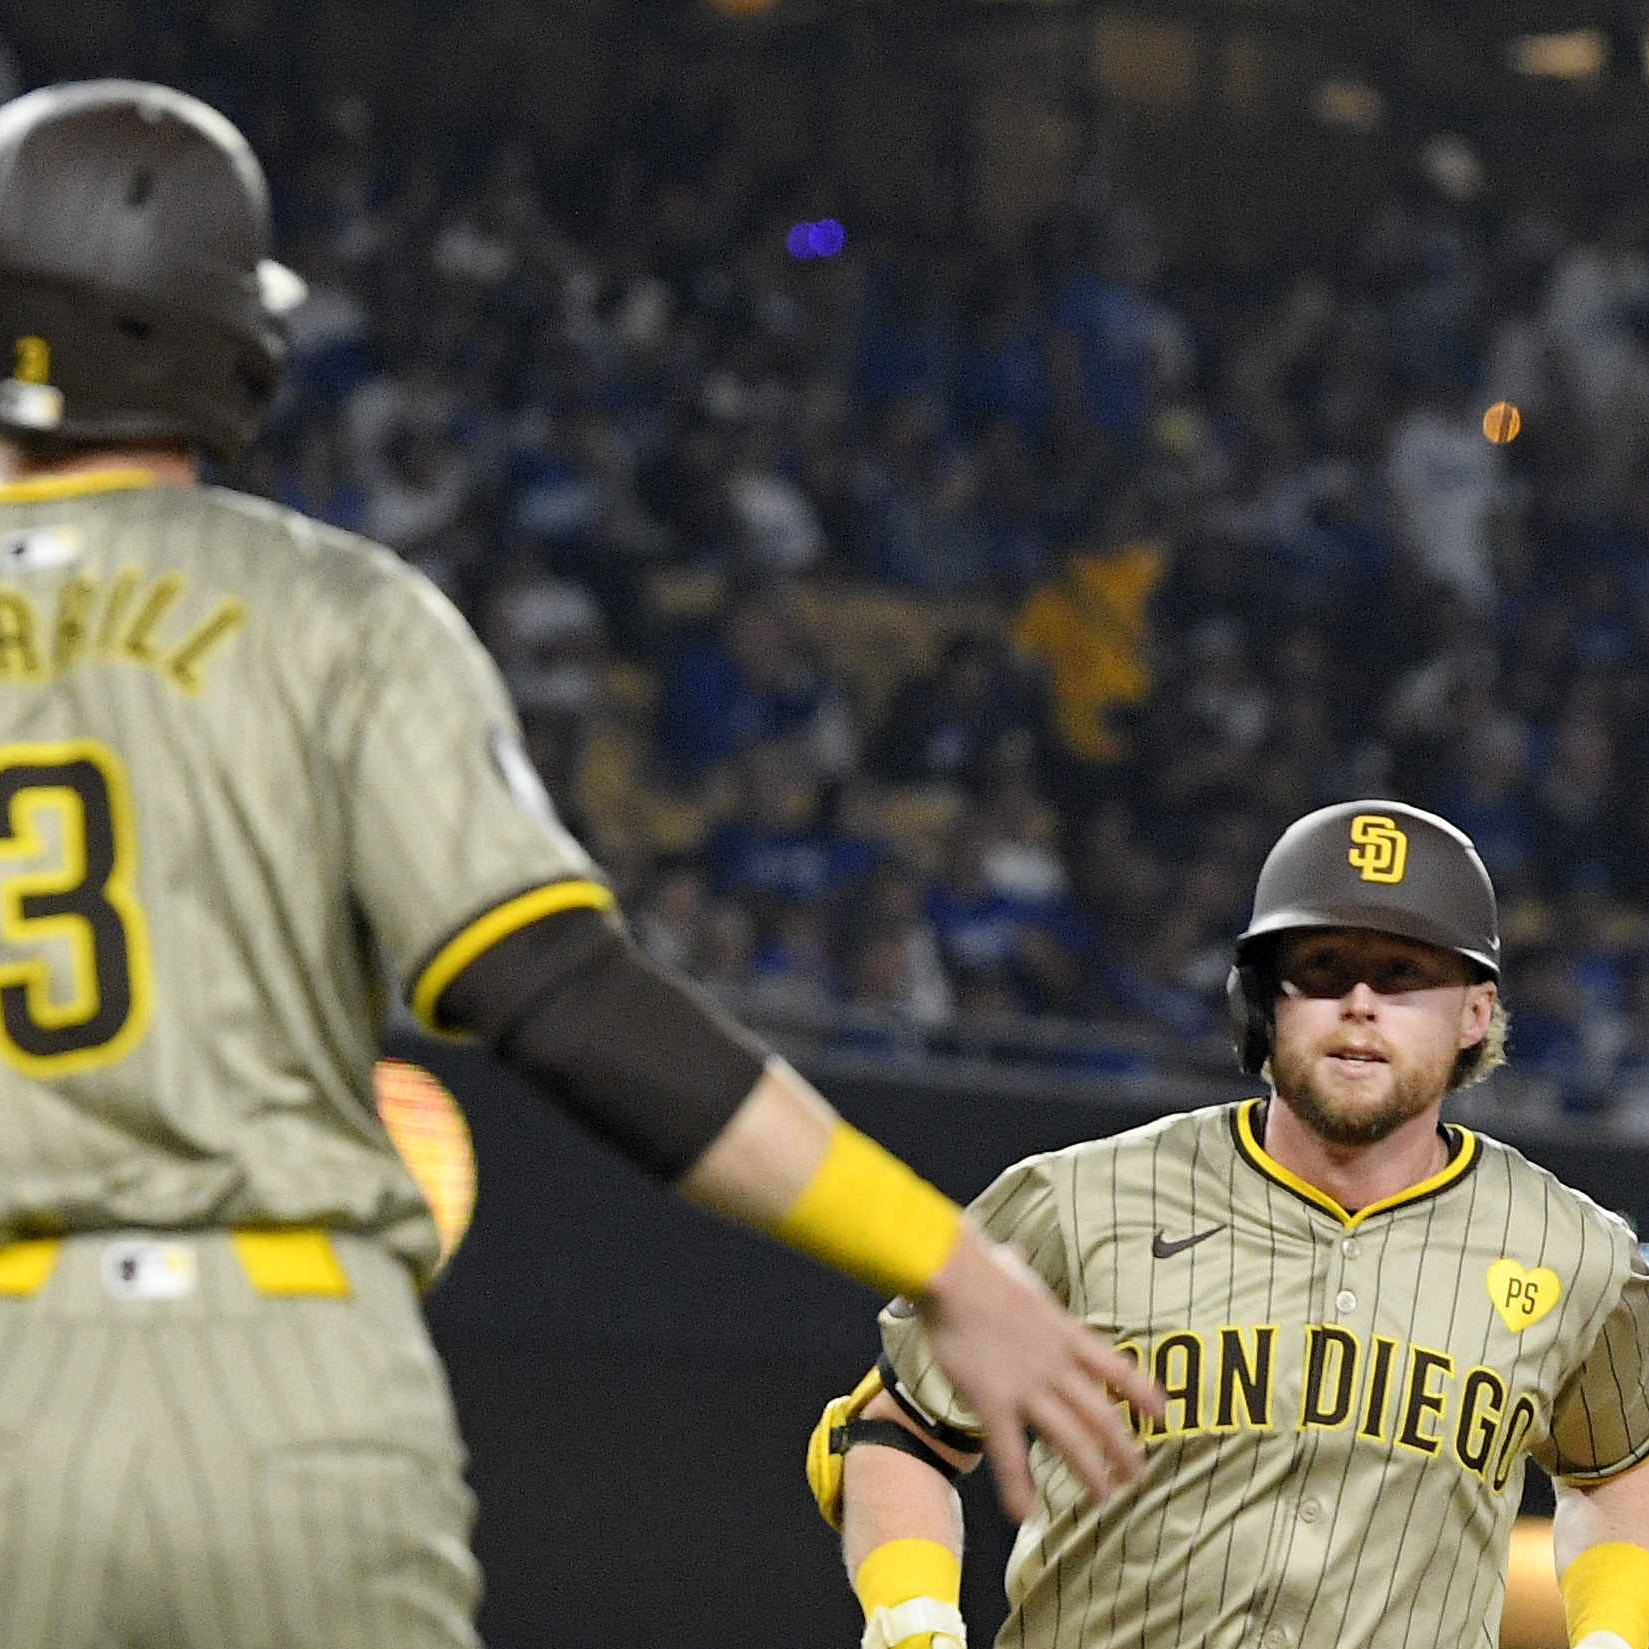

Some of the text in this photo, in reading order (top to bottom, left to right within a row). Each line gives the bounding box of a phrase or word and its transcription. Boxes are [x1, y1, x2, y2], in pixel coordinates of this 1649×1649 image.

[1348, 814, 1409, 884] SD
[1504, 1277, 1540, 1316] PS
[1298, 1322, 1539, 1497] DIEGO
